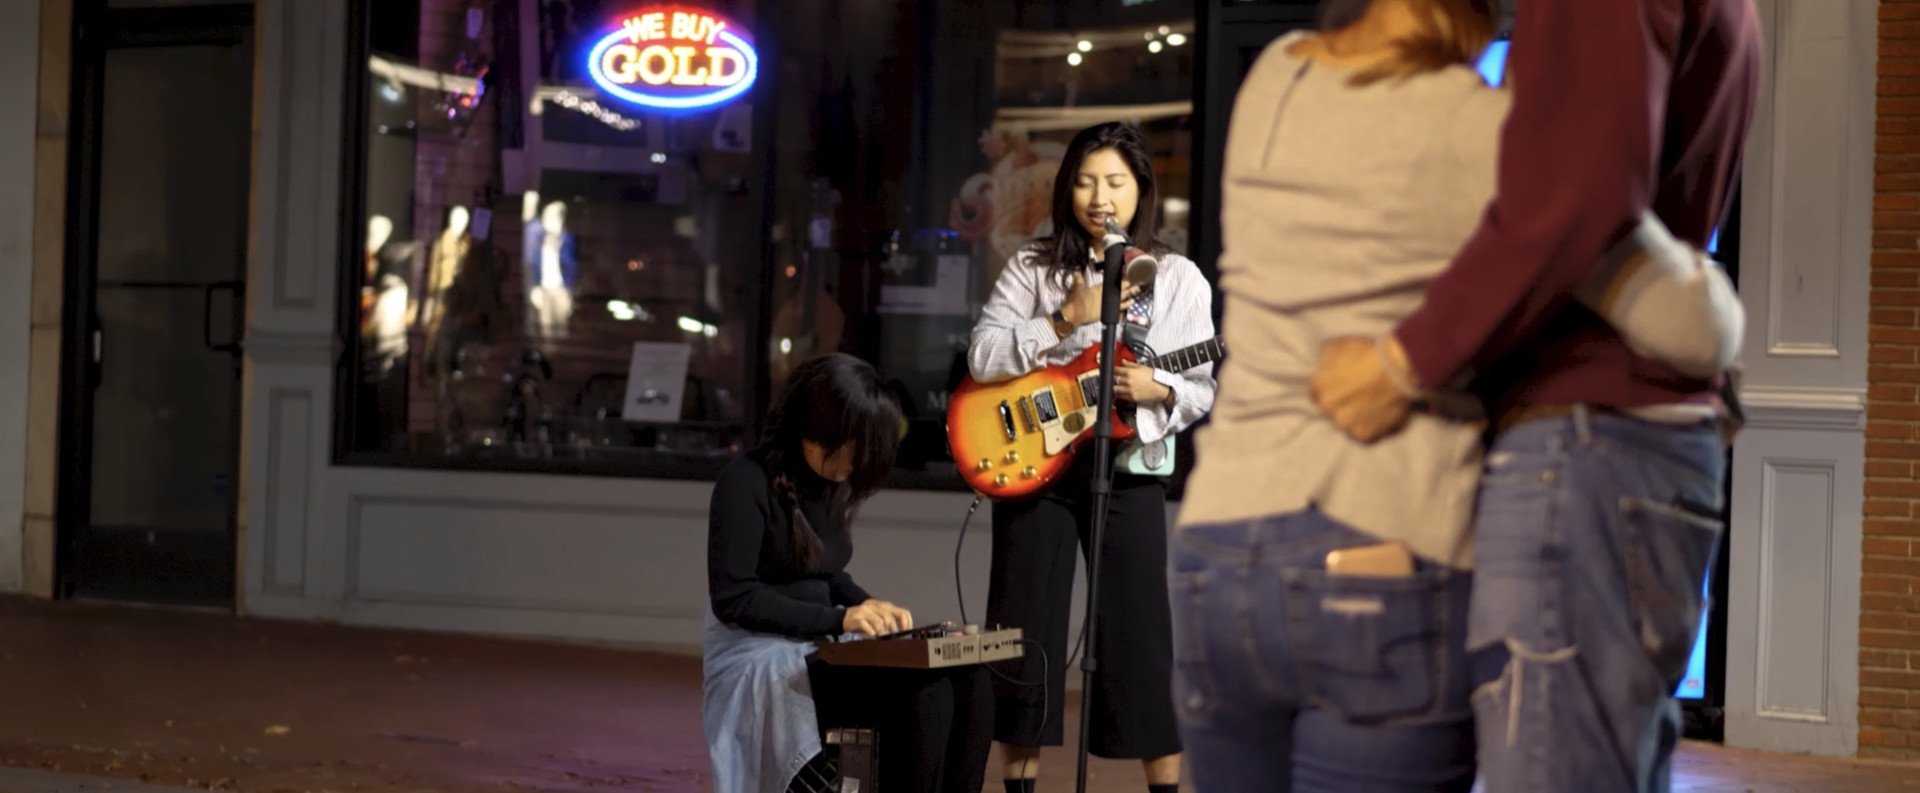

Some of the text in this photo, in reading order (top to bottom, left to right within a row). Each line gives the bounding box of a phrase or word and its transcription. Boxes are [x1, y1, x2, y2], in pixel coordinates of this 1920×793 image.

[624, 12, 726, 45] WE BUY
[602, 44, 746, 86] GOLD
[942, 642, 961, 661] KORG
